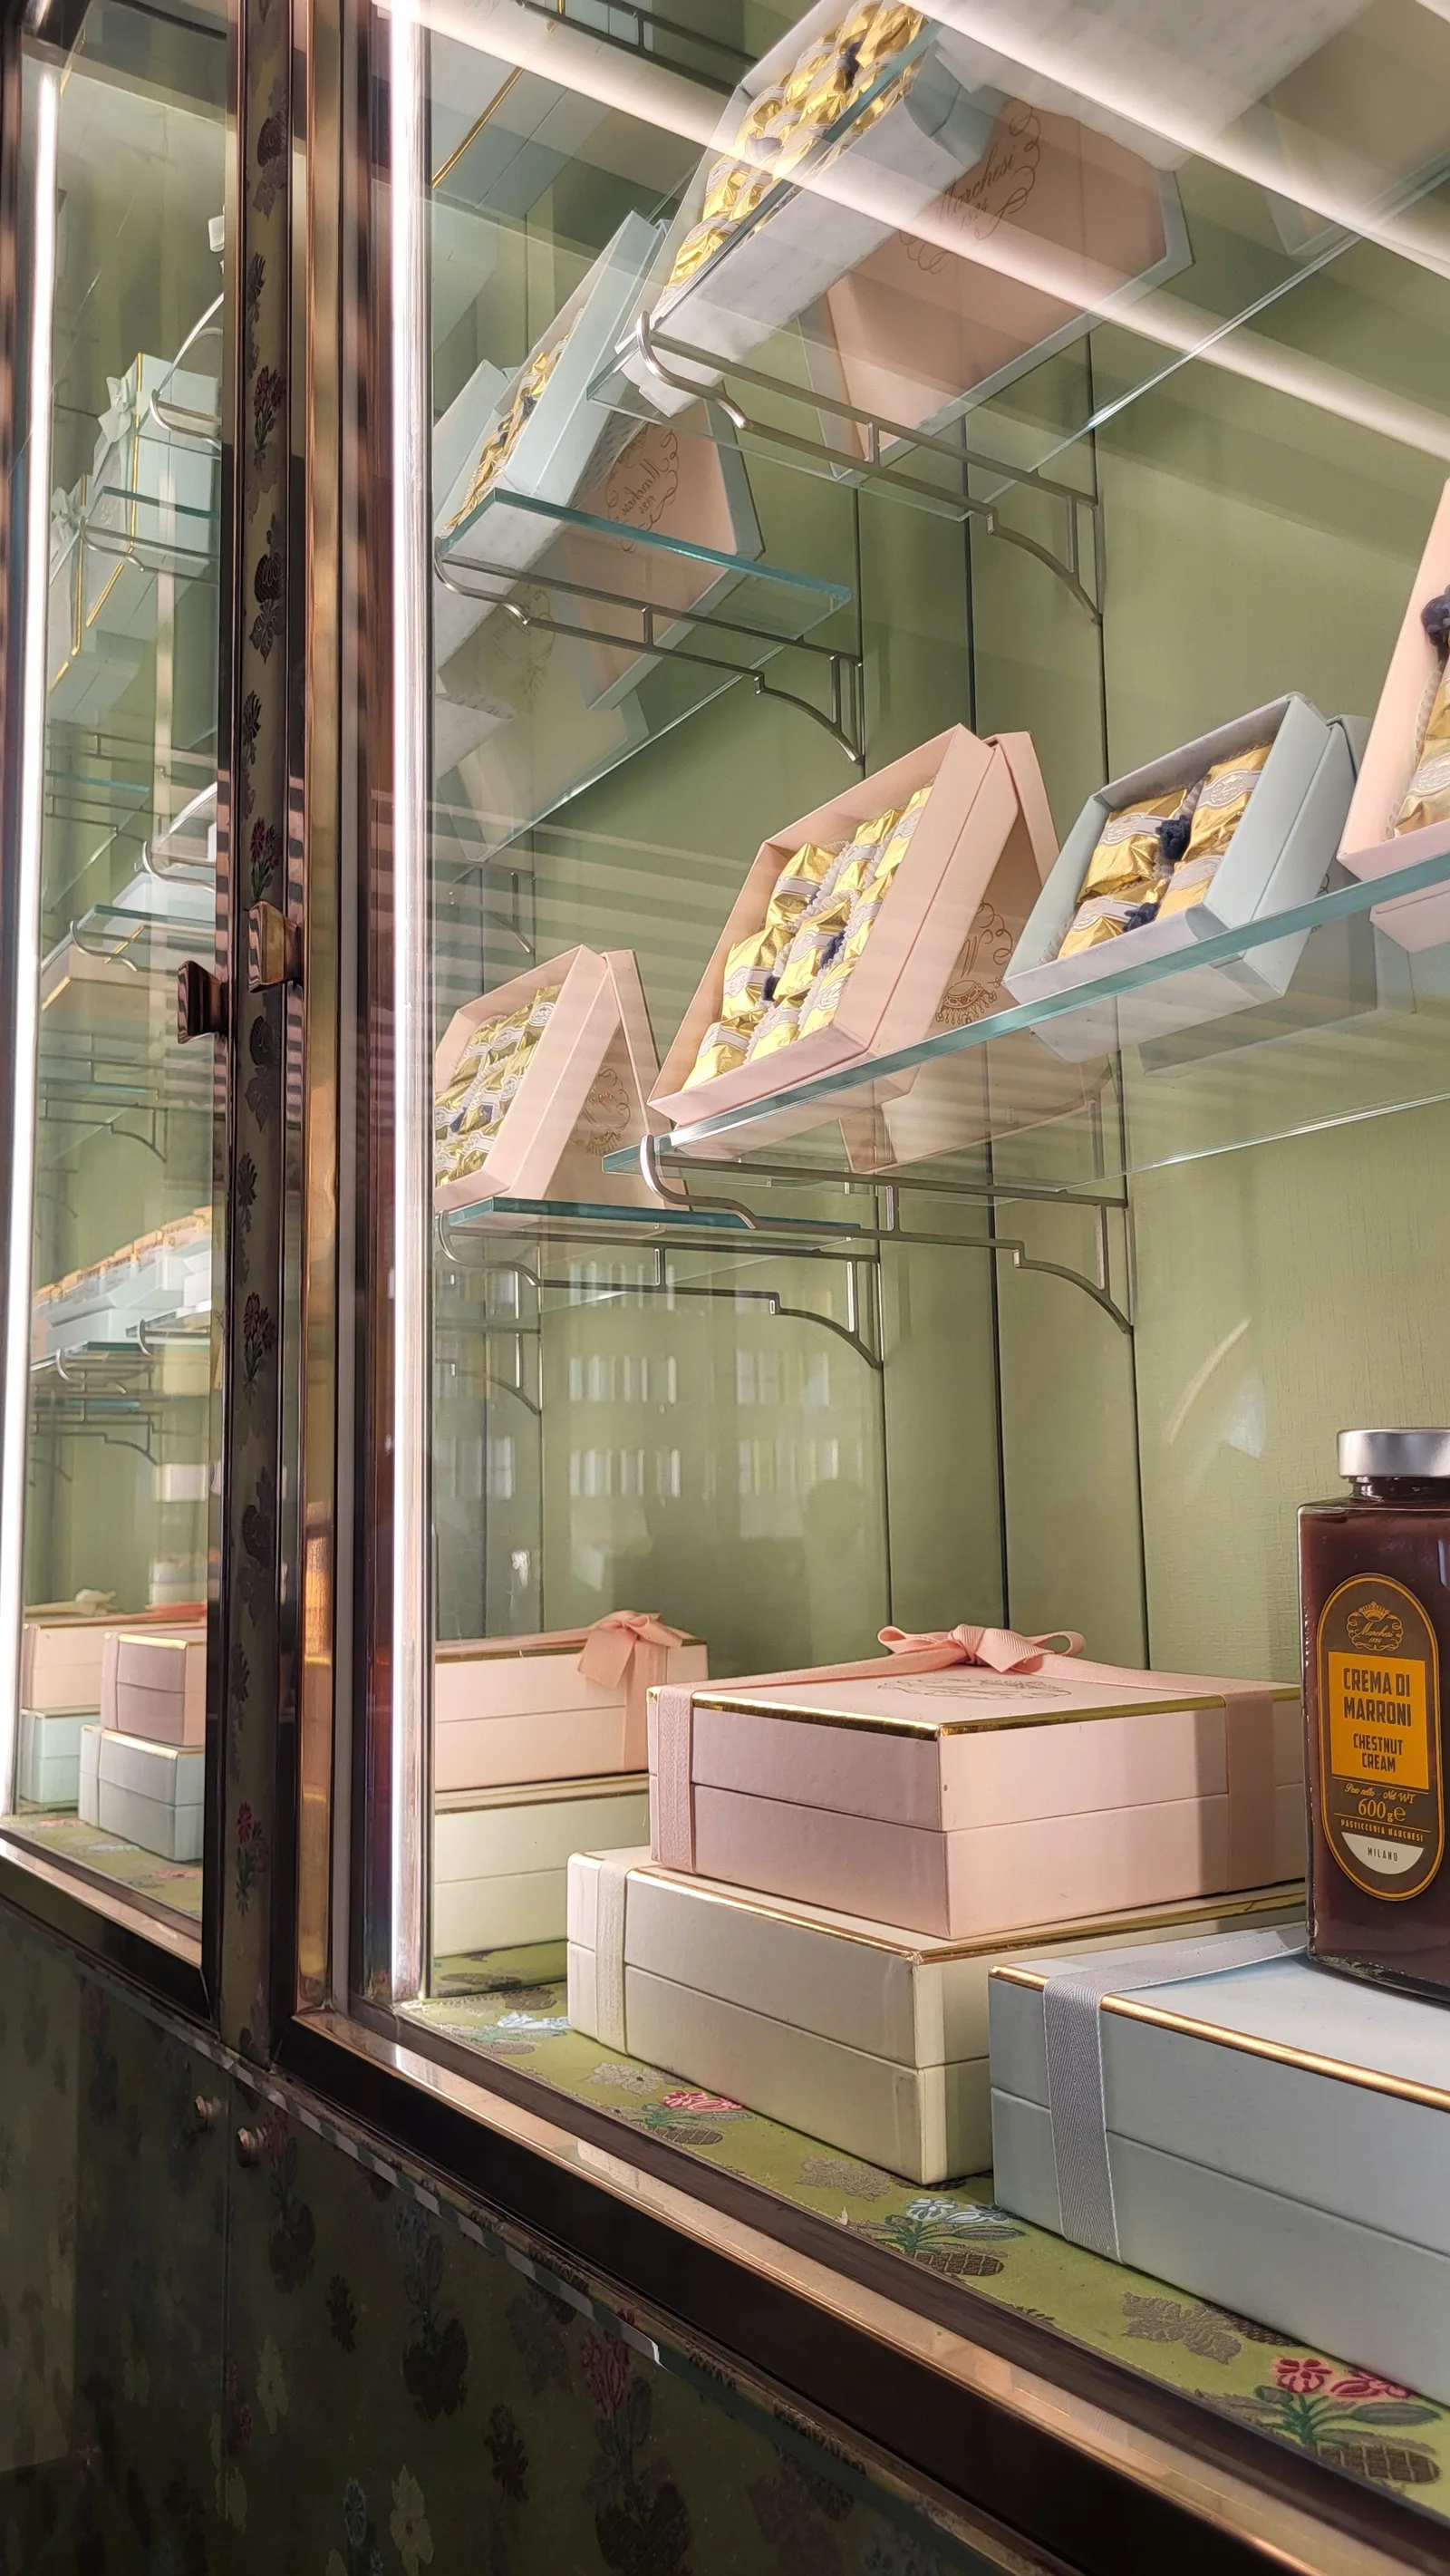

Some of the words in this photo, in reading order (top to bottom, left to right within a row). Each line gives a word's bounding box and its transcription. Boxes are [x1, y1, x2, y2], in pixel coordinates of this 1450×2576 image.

[1355, 1621, 1394, 1638] Marchesi
[1343, 1668, 1392, 1695] CREMA
[1396, 1673, 1411, 1697] DI
[1343, 1696, 1412, 1727] MARRONI
[1353, 1733, 1403, 1756] CHESTNUT
[1361, 1752, 1396, 1773] CREAM
[1341, 1819, 1385, 1834] PASTICCERIA
[1367, 1847, 1398, 1862] MILANO
